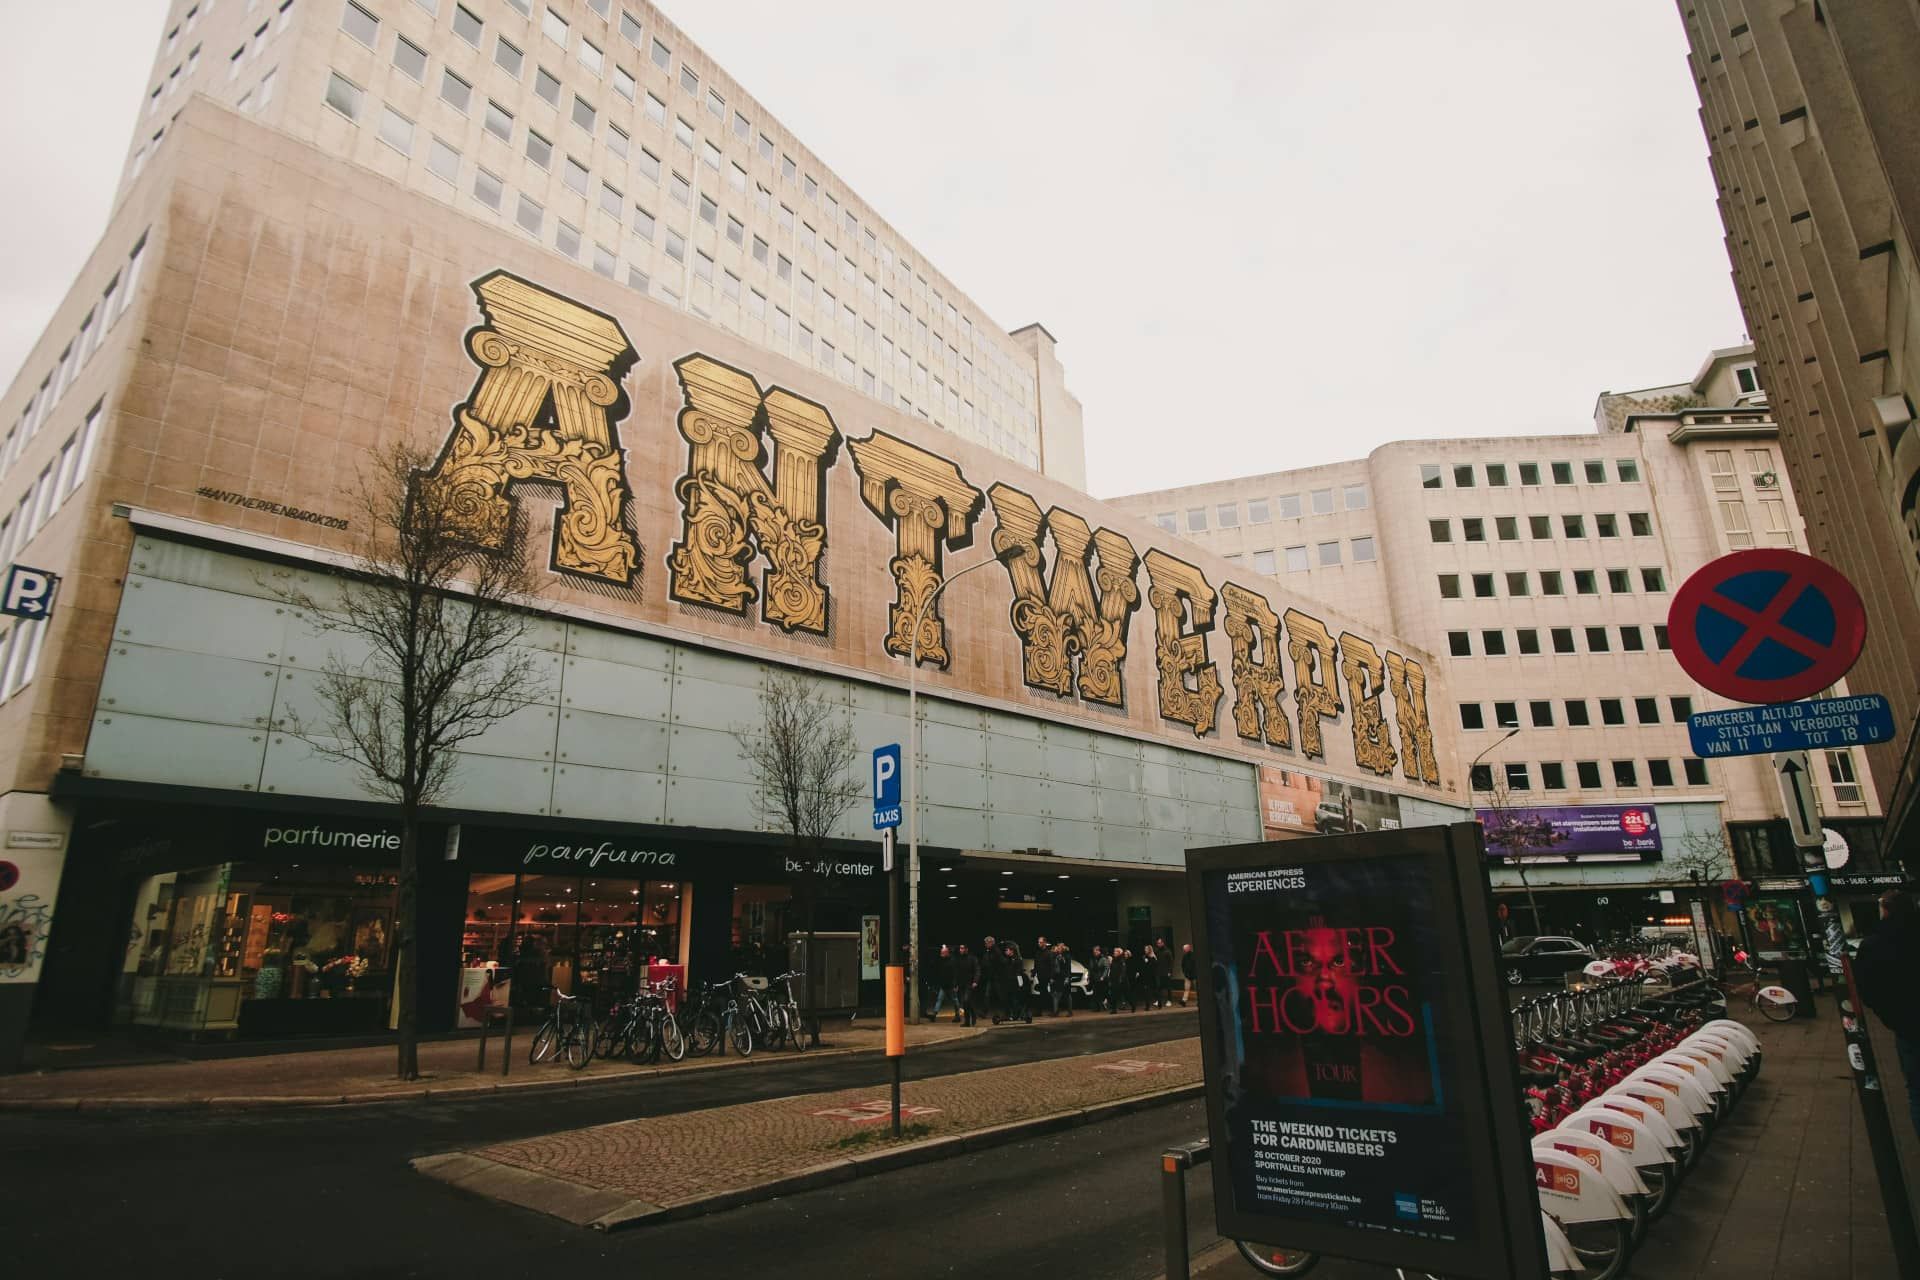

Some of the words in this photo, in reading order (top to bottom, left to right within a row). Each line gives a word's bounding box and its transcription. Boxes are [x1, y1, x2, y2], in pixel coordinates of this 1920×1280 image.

[6, 568, 48, 611] P
[1694, 711, 1754, 728] PARKEREN
[1762, 705, 1803, 721] ALTIJD
[1810, 697, 1881, 716] VERBODEN
[1718, 722, 1782, 740] STILSTAAN
[1790, 713, 1859, 732] VERBODEN
[1706, 740, 1731, 754] VAN
[1738, 738, 1749, 752] 11
[1763, 737, 1772, 749] U
[1805, 731, 1829, 745] TOT
[1842, 727, 1858, 742] 18
[1868, 726, 1878, 739] U
[876, 754, 896, 800] P
[874, 809, 899, 825] TAXIS
[264, 826, 401, 849] parfumerie
[523, 842, 675, 868] parfuma
[785, 857, 832, 878] beuty
[835, 862, 874, 876] center
[1228, 871, 1267, 881] AMERICAN
[1268, 868, 1304, 878] EXPRESS
[1227, 877, 1306, 893] EXPERIENCES
[1248, 927, 1408, 978] AFER
[1312, 1062, 1359, 1083] TOUR
[1251, 1119, 1277, 1133] THE
[1279, 1121, 1334, 1138] WEEKND
[1336, 1127, 1397, 1143] TICKETS
[1253, 1133, 1278, 1147] FOR
[1281, 1135, 1385, 1157] CARDMEMBERS
[1255, 1160, 1305, 1174] SPORTPALEIS
[1307, 1165, 1346, 1178] ANTWERP
[1265, 1151, 1300, 1162] OCTOBER
[1302, 1155, 1322, 1165] 2020
